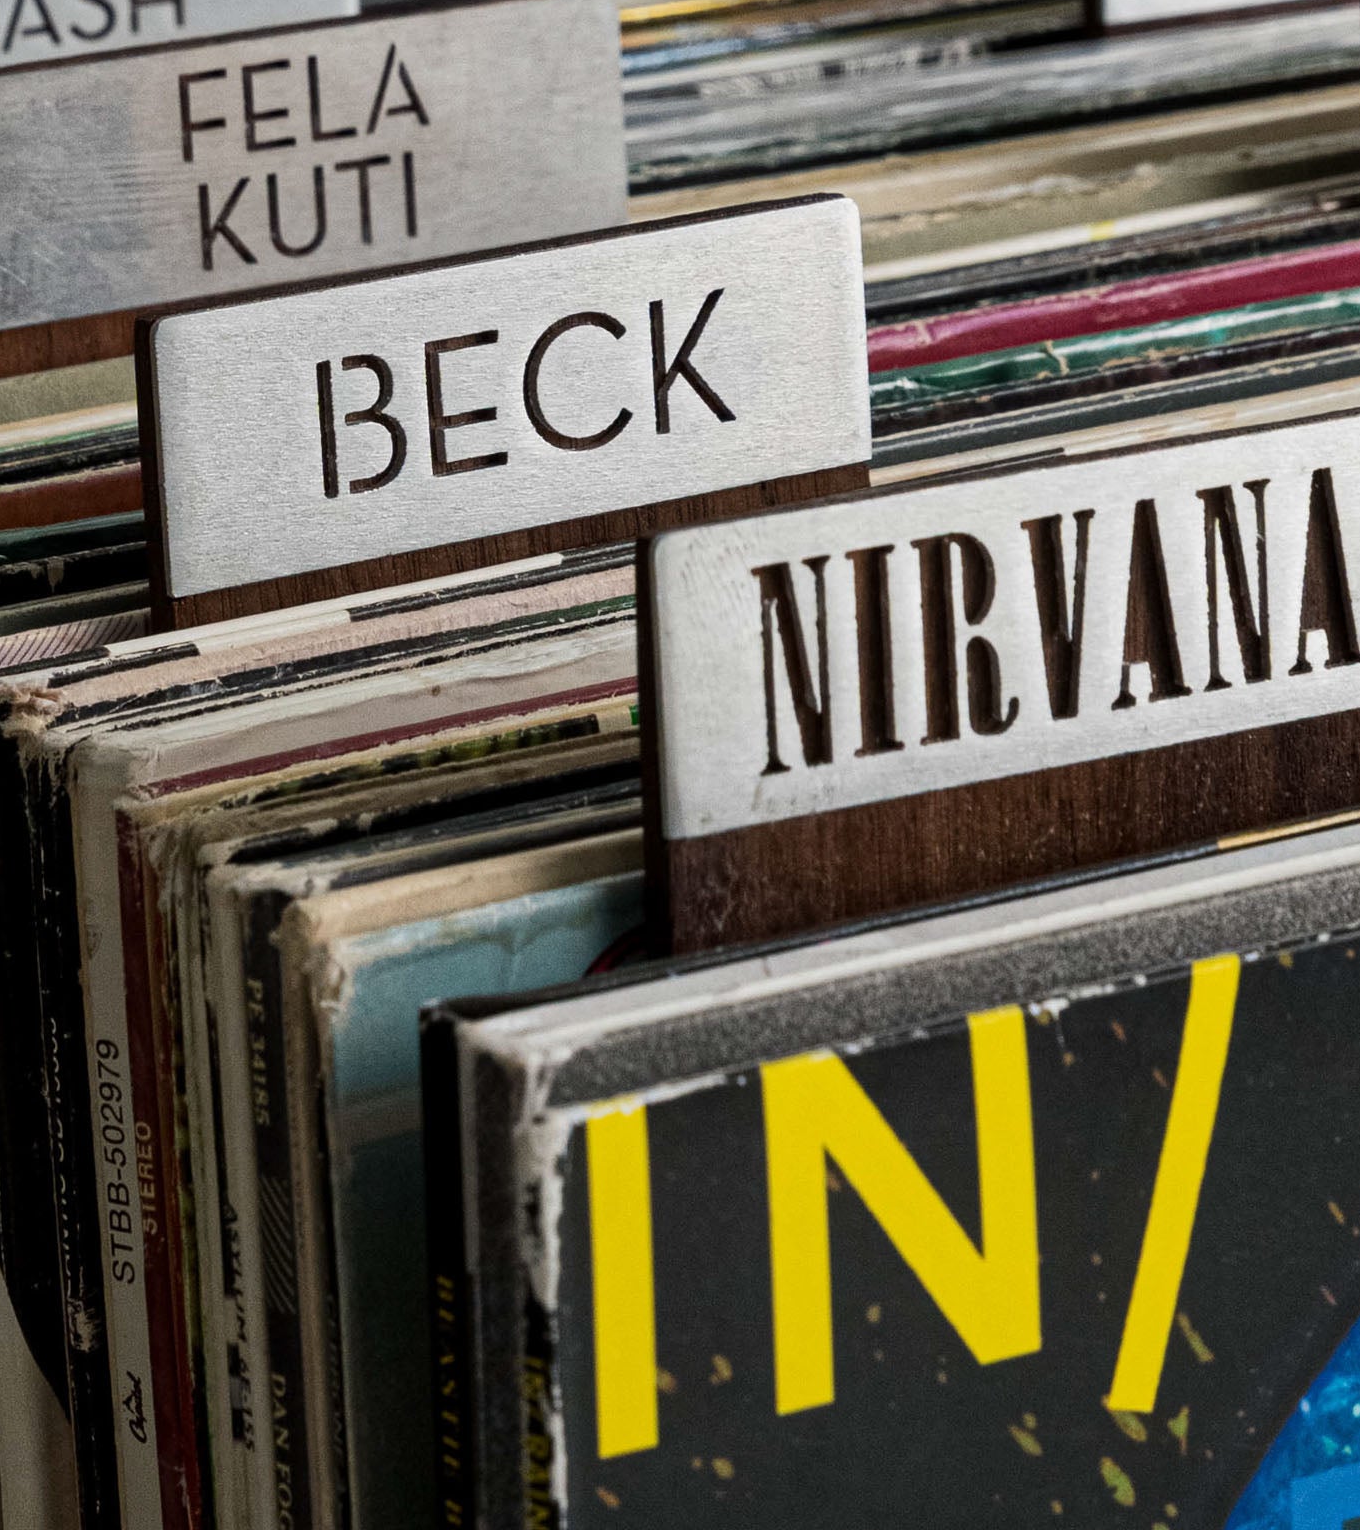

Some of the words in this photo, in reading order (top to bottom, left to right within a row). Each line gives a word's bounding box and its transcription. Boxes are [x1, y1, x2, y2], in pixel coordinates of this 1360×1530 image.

[177, 42, 430, 163] FELA
[196, 150, 418, 271] KUTI
[315, 287, 737, 500] BECK
[93, 1038, 136, 1286] STBB-502979
[133, 1121, 157, 1237] STEREO
[268, 1370, 291, 1451] DAN
